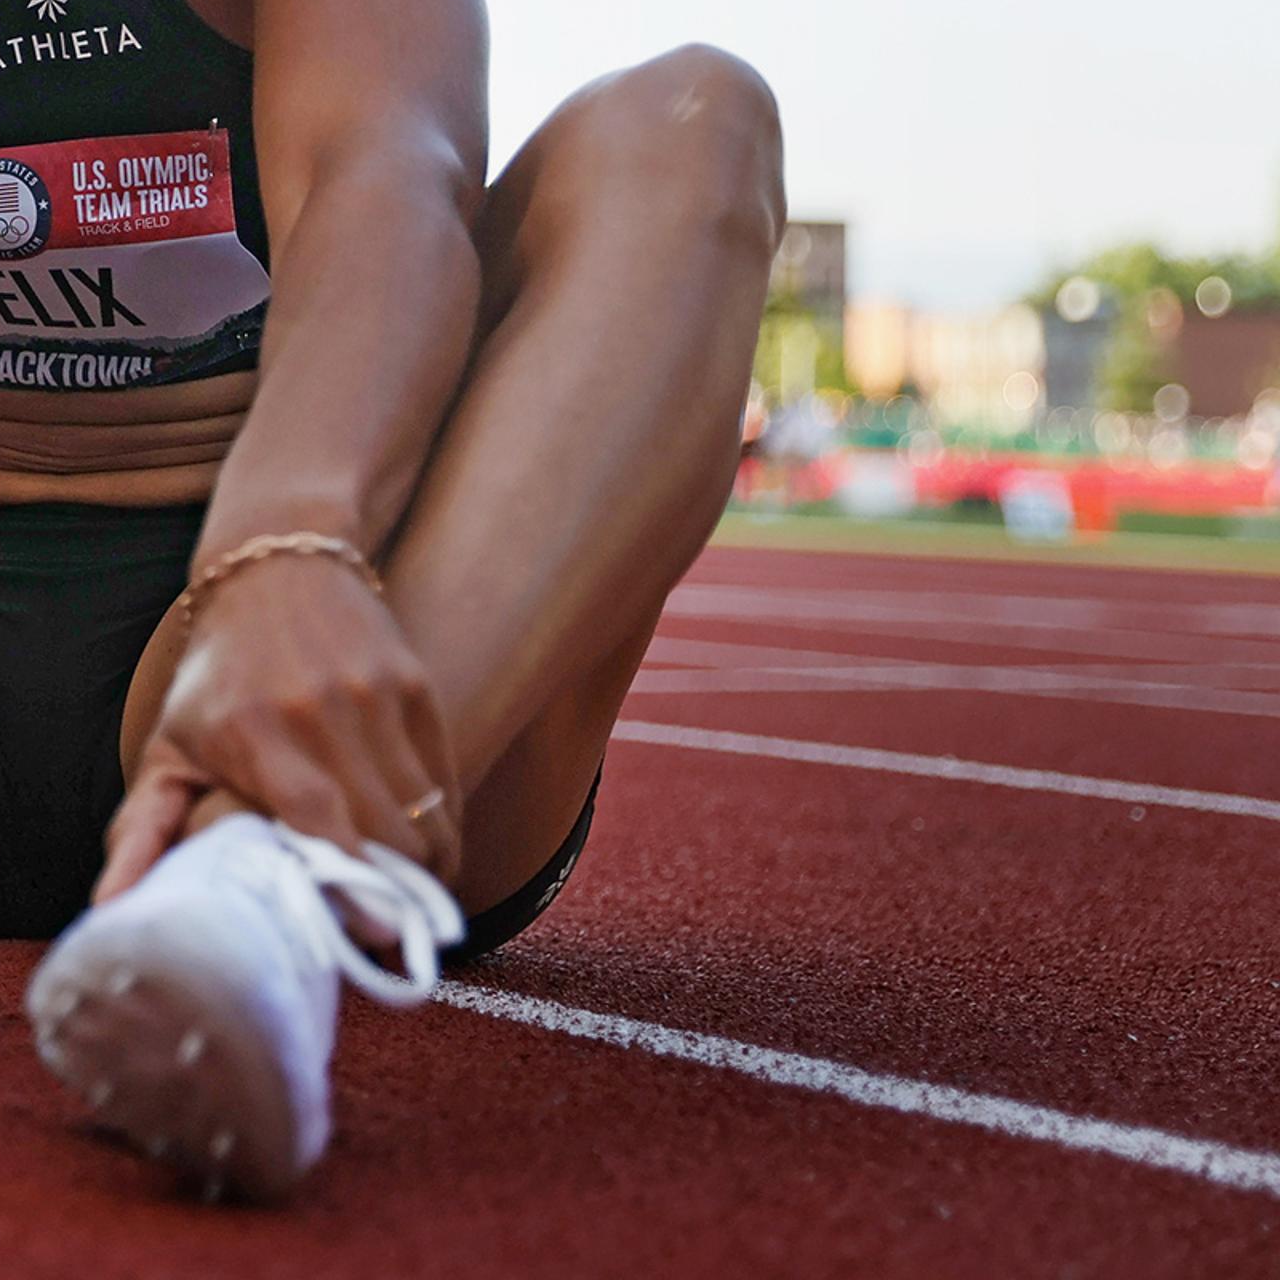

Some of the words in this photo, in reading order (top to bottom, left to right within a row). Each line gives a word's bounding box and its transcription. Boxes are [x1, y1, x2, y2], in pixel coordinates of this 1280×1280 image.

[0, 160, 40, 186] STATES
[72, 159, 113, 192] U.S.
[117, 152, 209, 188] OLYMPIC
[72, 190, 132, 224] TEAM
[137, 184, 209, 216] TRIALS
[78, 223, 121, 237] TRACK
[123, 220, 132, 233] &
[134, 215, 171, 231] FIELD
